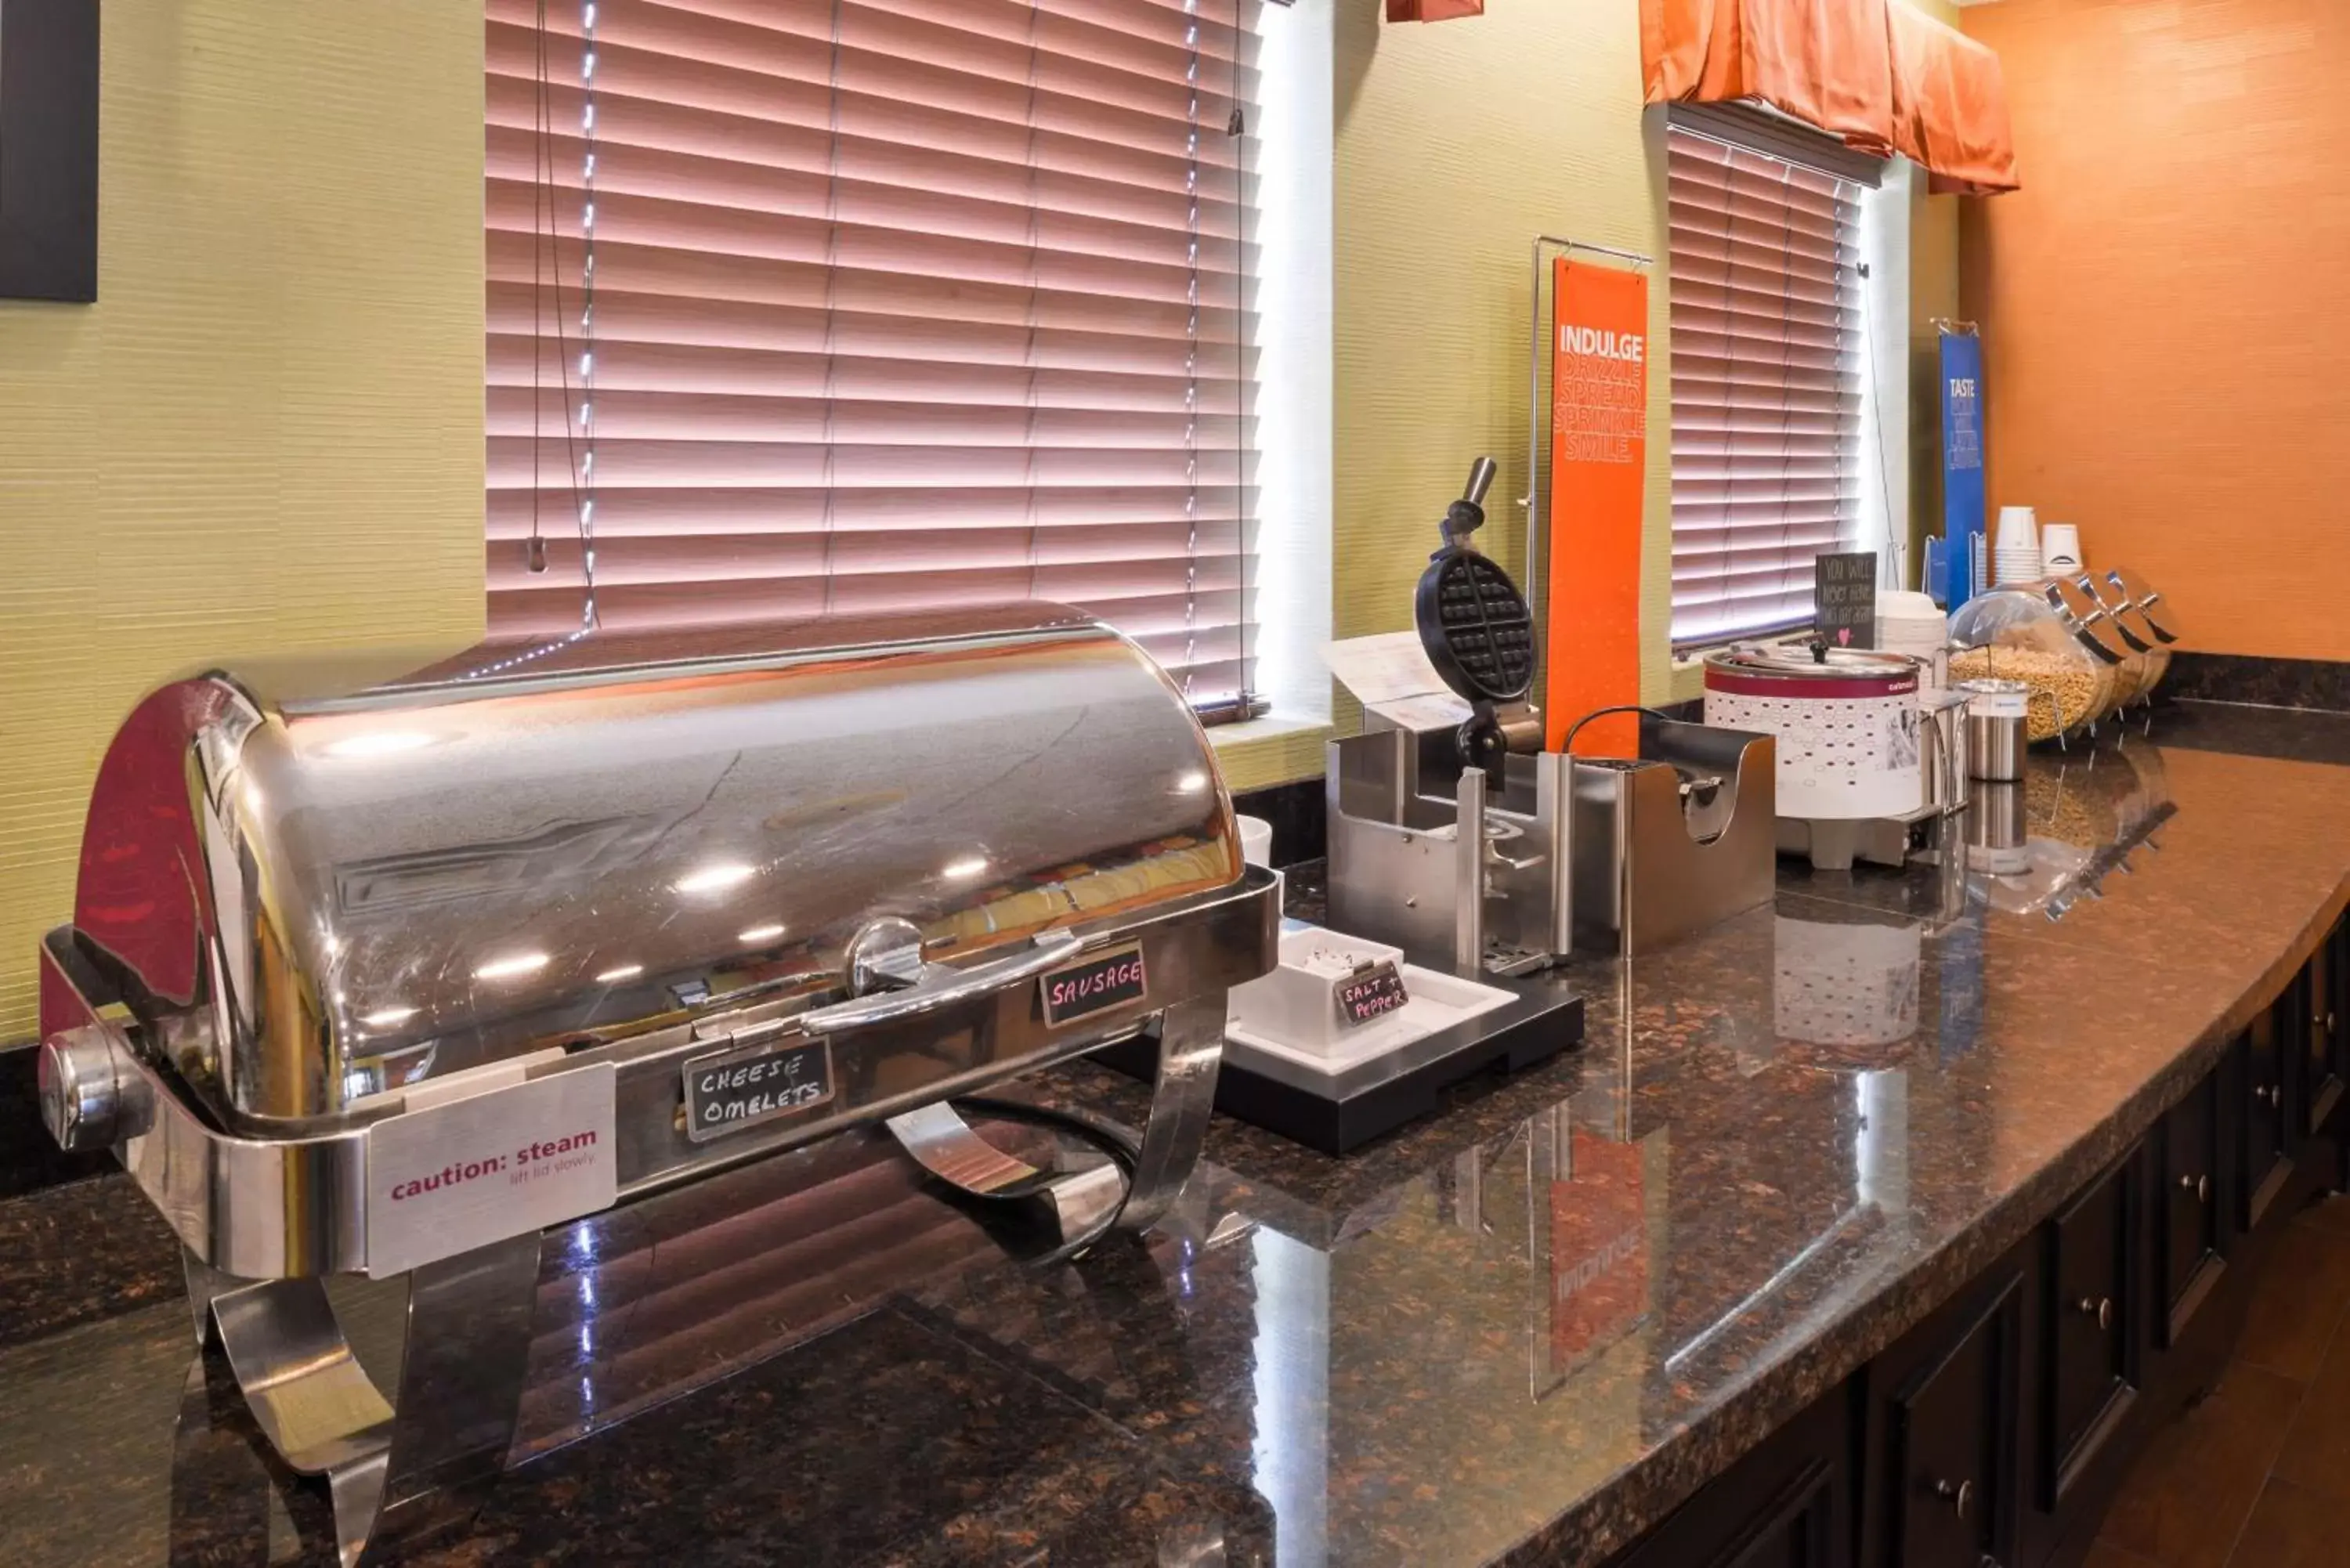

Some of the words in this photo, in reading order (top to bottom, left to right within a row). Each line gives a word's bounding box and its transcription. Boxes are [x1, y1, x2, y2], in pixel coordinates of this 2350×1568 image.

[1560, 325, 1643, 361] INDULGE
[1560, 379, 1642, 411] SPREAD
[1950, 378, 1975, 397] TASTE
[1565, 432, 1634, 462] SMILE
[1050, 961, 1143, 1006] SAUSAGE
[1345, 979, 1381, 1003] SALT
[1355, 990, 1403, 1017] PEPPER
[701, 1055, 804, 1093] CHEESE
[705, 1082, 821, 1122] OMELETS
[392, 1154, 508, 1201] caution:
[516, 1130, 597, 1165] steam
[510, 1169, 529, 1186] lift
[533, 1162, 550, 1179] lid
